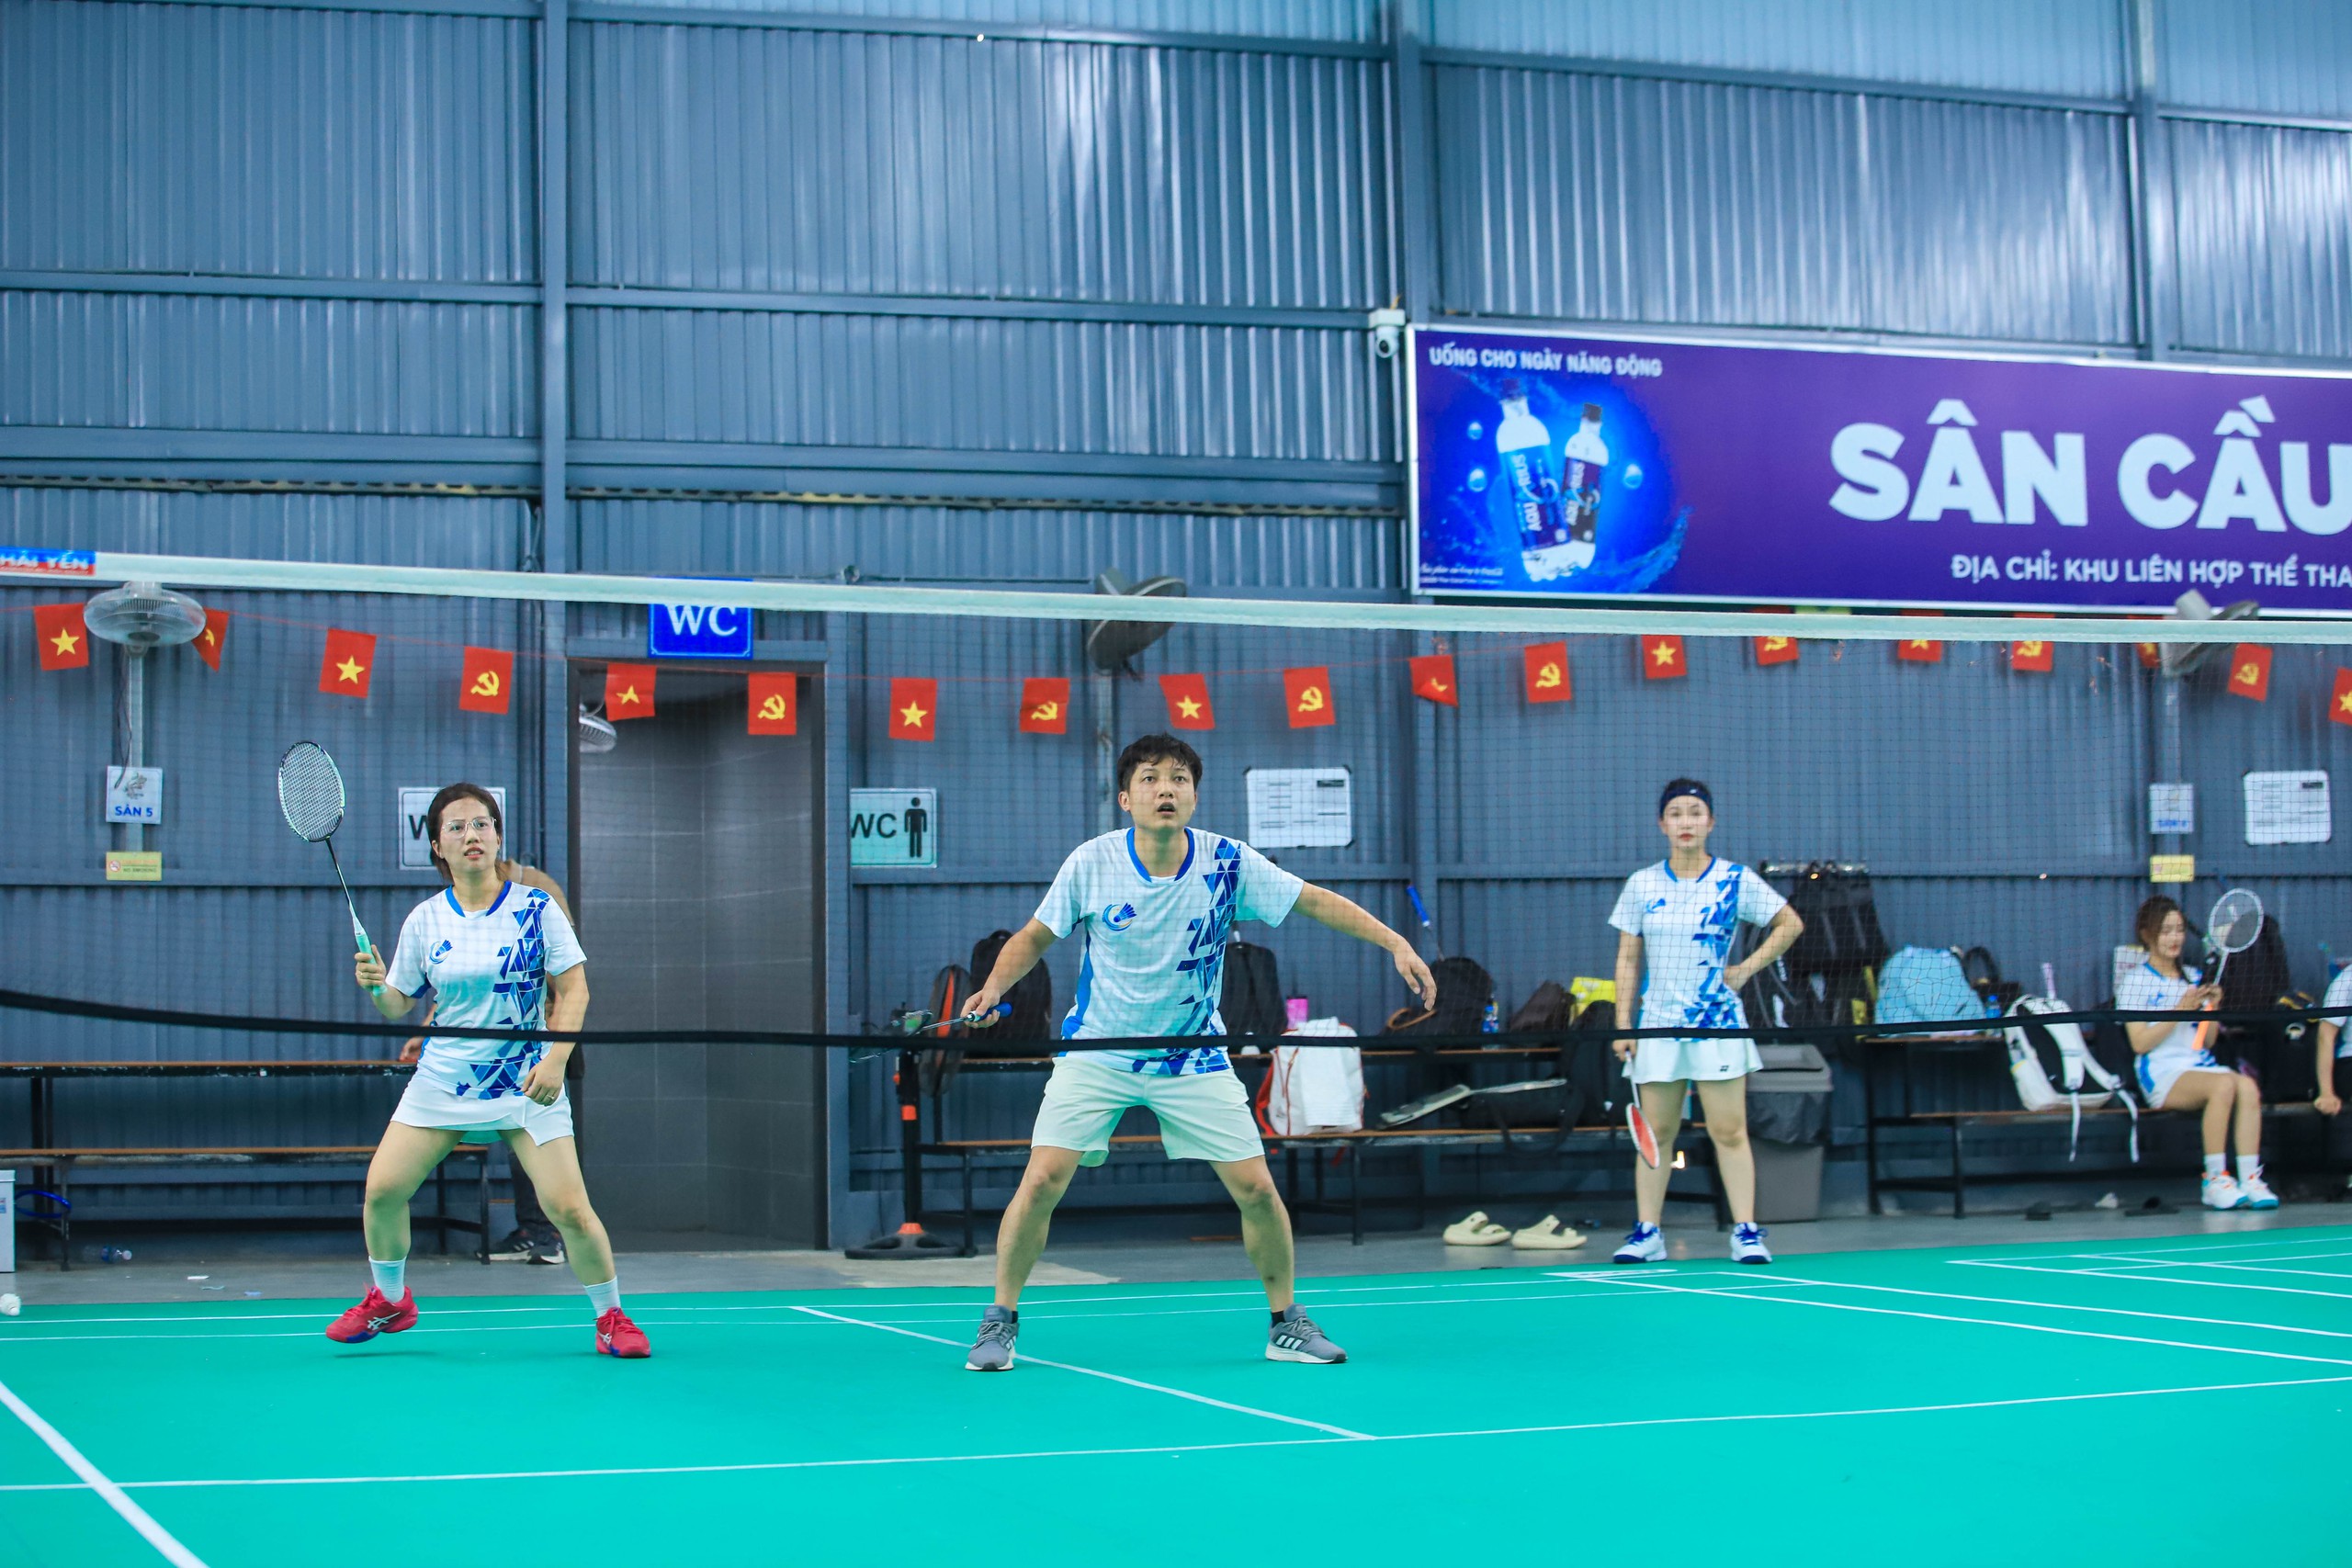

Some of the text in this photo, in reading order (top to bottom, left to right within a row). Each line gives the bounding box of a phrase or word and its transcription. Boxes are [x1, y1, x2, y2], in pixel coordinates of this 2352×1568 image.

[1429, 342, 1662, 378] UỐNG CHO NGÀY NĂNG ĐỘNG
[1828, 395, 2352, 536] SÂN CẦU
[1951, 554, 2000, 584] ĐỊA
[2006, 548, 2058, 581] CHỈ:
[2064, 558, 2119, 582] KHU
[2124, 553, 2183, 583] LIÊN
[2188, 558, 2244, 589] HỢP
[664, 604, 737, 637] WC
[145, 807, 153, 818] 5
[408, 814, 430, 840] W
